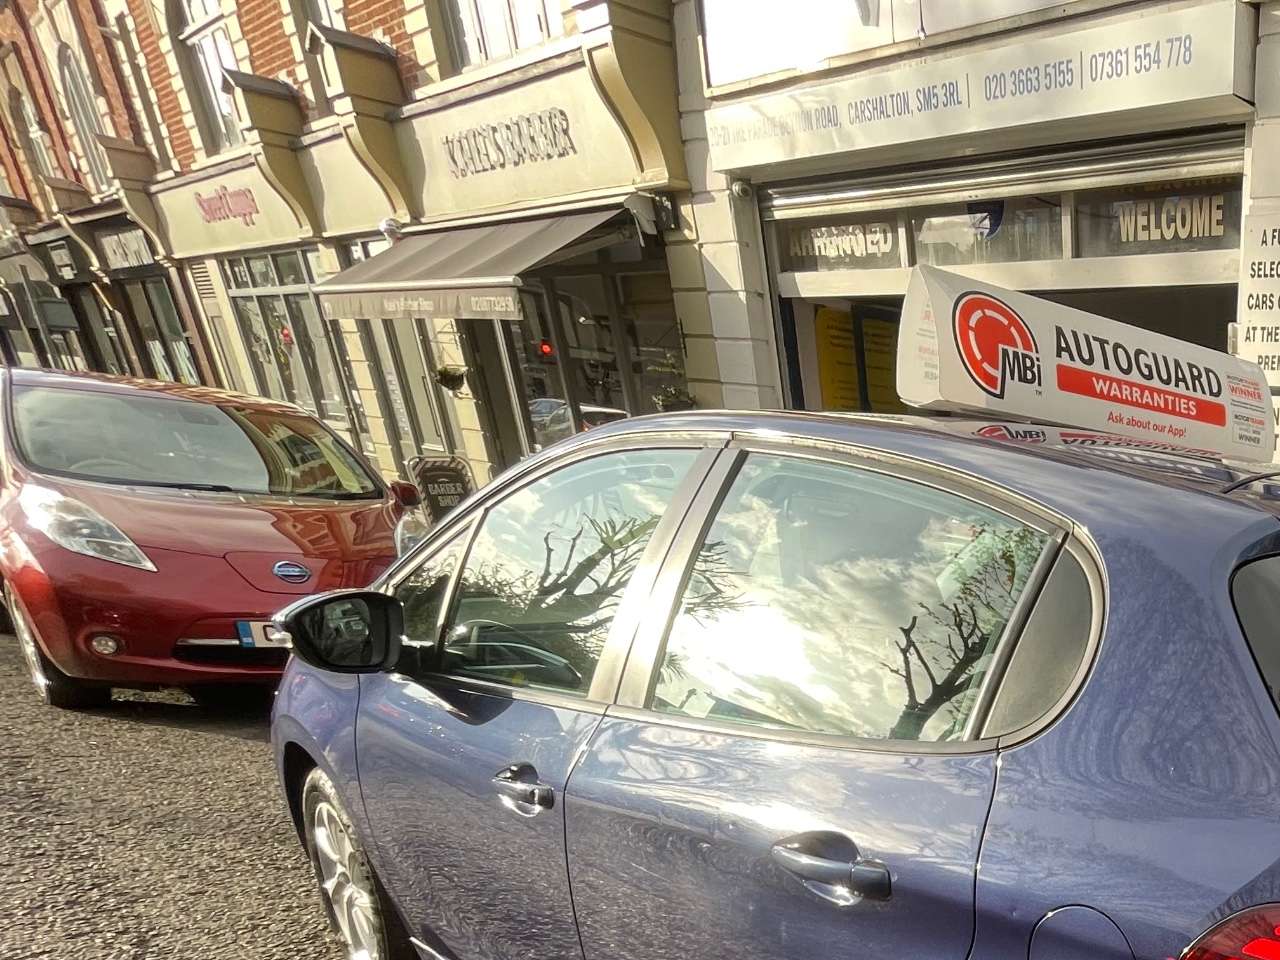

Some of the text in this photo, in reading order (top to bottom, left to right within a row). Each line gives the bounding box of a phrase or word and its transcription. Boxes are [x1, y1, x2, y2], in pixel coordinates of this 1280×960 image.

[815, 106, 841, 130] ROAD,
[848, 93, 914, 125] CARSHALTON,
[915, 85, 939, 113] SM5
[941, 80, 963, 108] 3RL
[984, 72, 1006, 101] 020
[1010, 66, 1040, 96] 3663
[1044, 59, 1074, 90] 5155
[1090, 47, 1129, 82] 07361
[1135, 40, 1161, 74] 554
[1166, 34, 1193, 68] 778
[1120, 195, 1224, 242] WELCOME
[1260, 229, 1268, 246] A
[1247, 293, 1275, 310] CARS
[1244, 326, 1258, 342] AT
[1260, 326, 1279, 342] THE
[1055, 325, 1222, 398] AUTOGUARD
[1092, 377, 1197, 416] WARRANTIES
[1107, 411, 1187, 439] Ask about our App!
